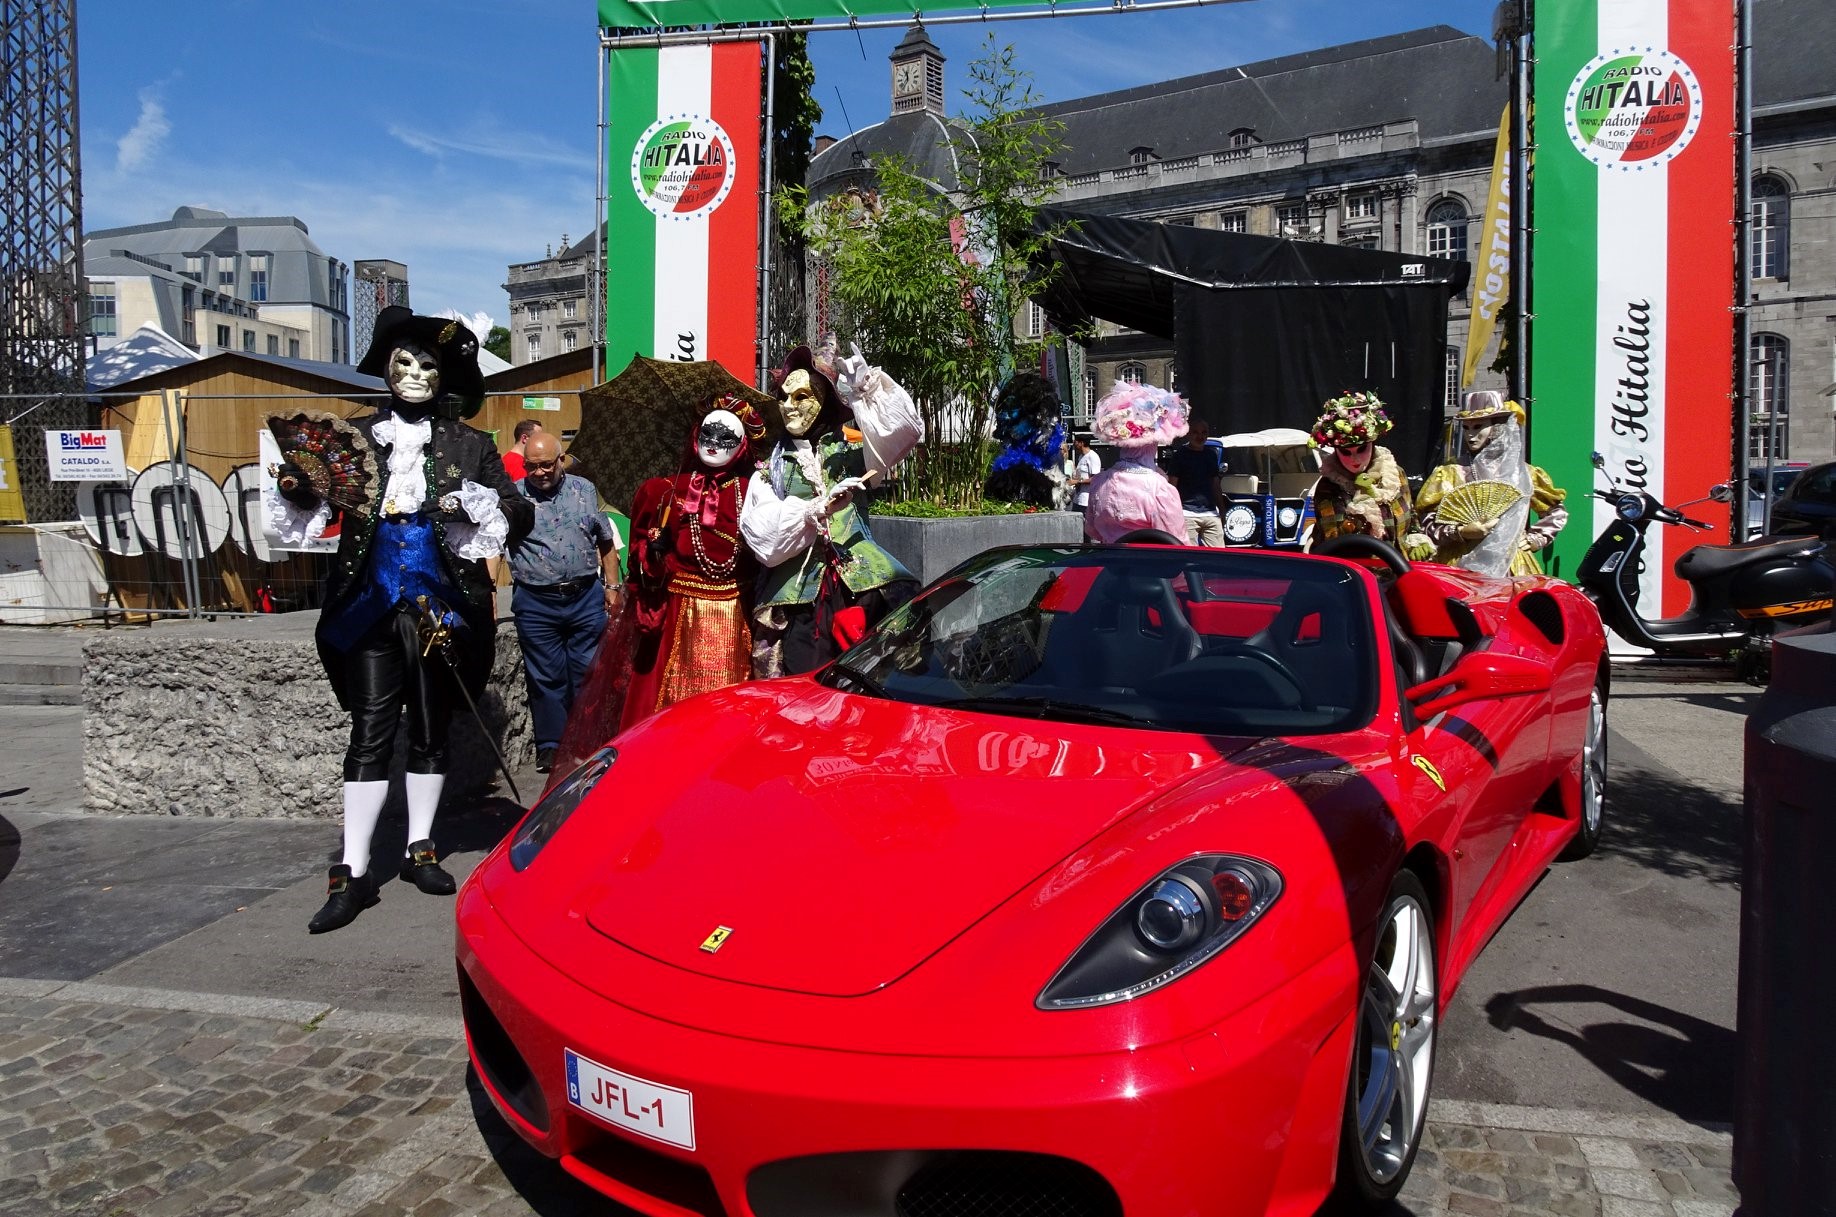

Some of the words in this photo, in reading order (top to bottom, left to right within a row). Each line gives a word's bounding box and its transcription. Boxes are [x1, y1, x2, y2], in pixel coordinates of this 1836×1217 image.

[1603, 67, 1662, 79] RADIO
[1581, 80, 1684, 110] HITALIA
[1581, 111, 1685, 126] www.radiohitalia.com
[661, 131, 706, 141] RADIO
[644, 143, 722, 168] HITALIA
[643, 170, 722, 182] www.radiohitalia.com
[1611, 298, 1651, 442] Hitalia
[60, 432, 107, 449] BigMat
[570, 1082, 578, 1100] B
[591, 1077, 664, 1128] JFL-1
